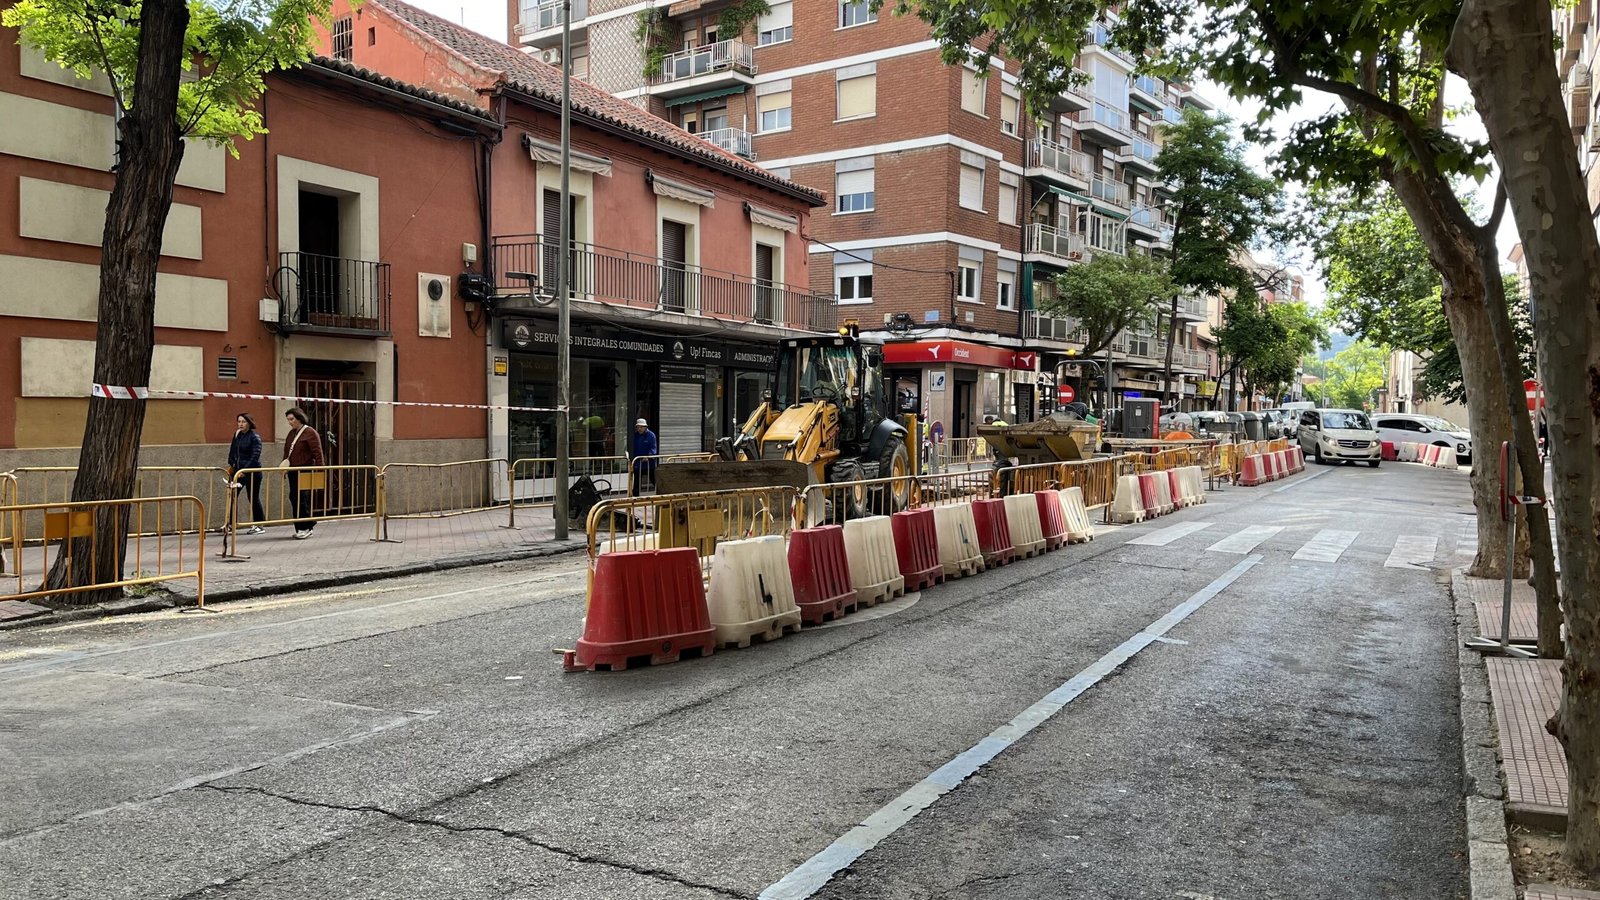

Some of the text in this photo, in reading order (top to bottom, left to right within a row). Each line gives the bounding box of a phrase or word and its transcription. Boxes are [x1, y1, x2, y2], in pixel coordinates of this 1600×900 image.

[534, 332, 574, 345] SERVIS
[574, 335, 618, 349] INTEGRALES
[619, 340, 664, 353] COMUNIDADES
[689, 346, 701, 359] Up!
[701, 347, 722, 359] Fincas
